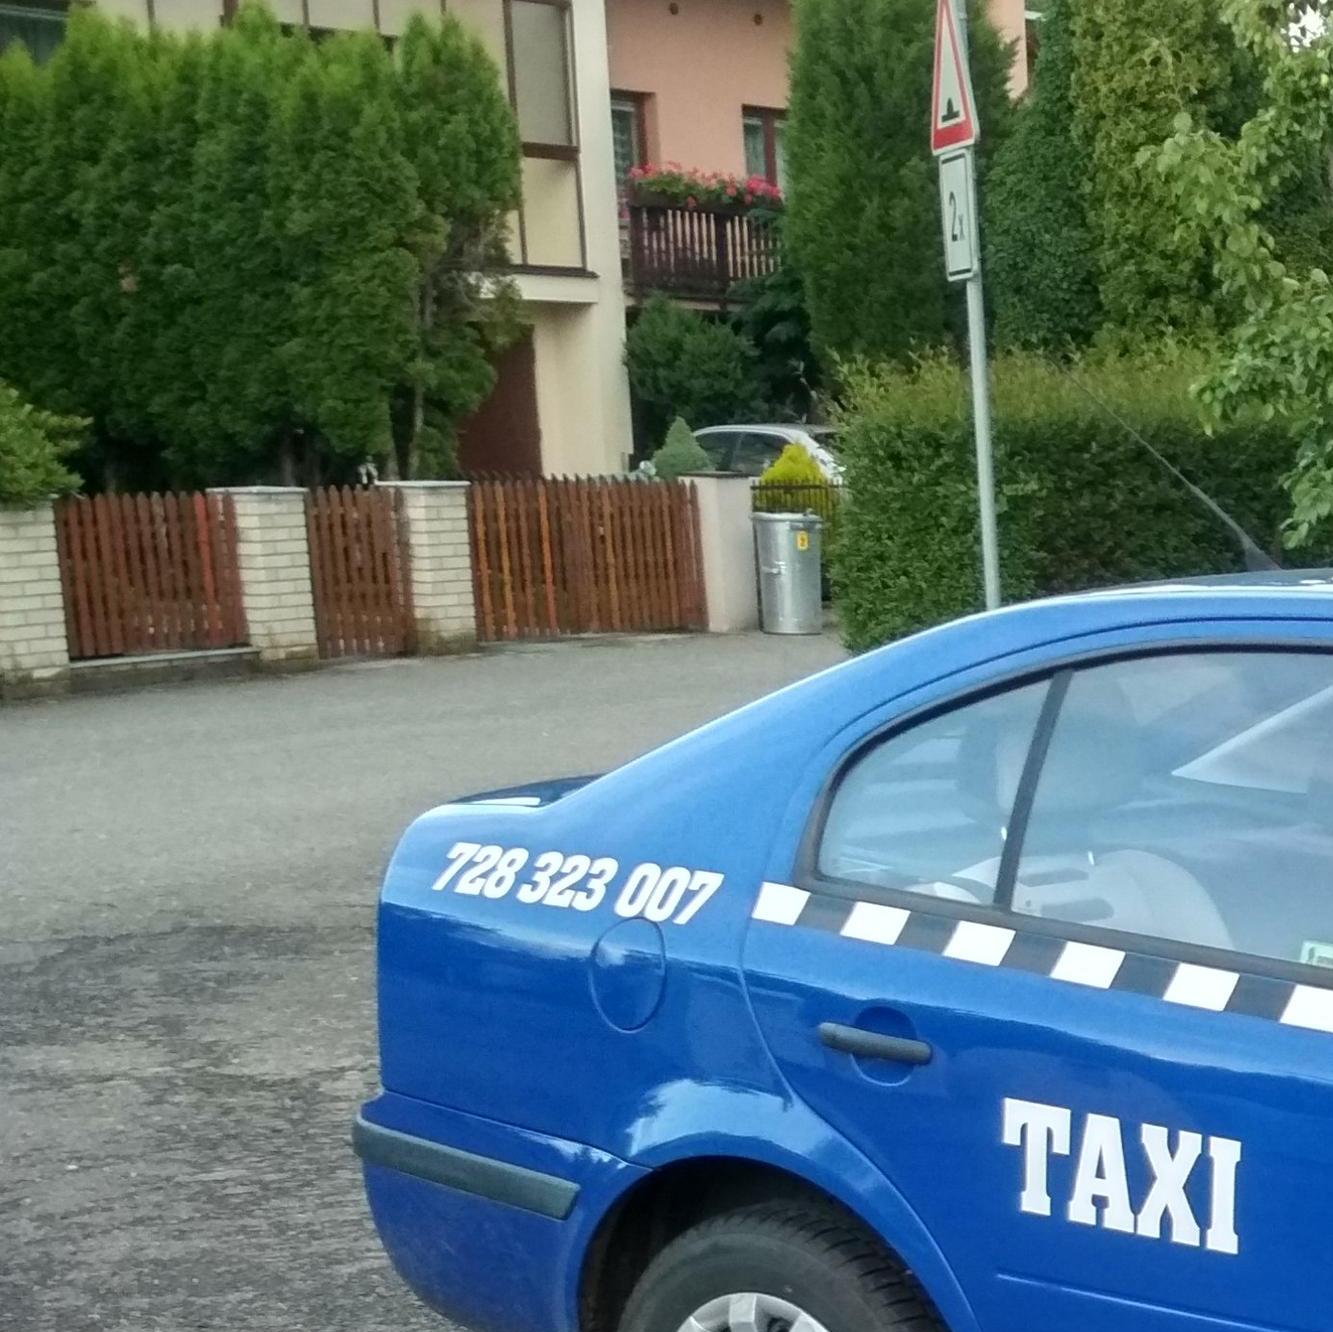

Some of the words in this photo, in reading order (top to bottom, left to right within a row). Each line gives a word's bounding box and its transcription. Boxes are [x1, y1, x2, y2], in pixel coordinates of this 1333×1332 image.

[432, 842, 529, 898] 728
[516, 851, 618, 911] 323
[614, 863, 724, 925] 007
[1003, 1097, 1241, 1254] TAXI
